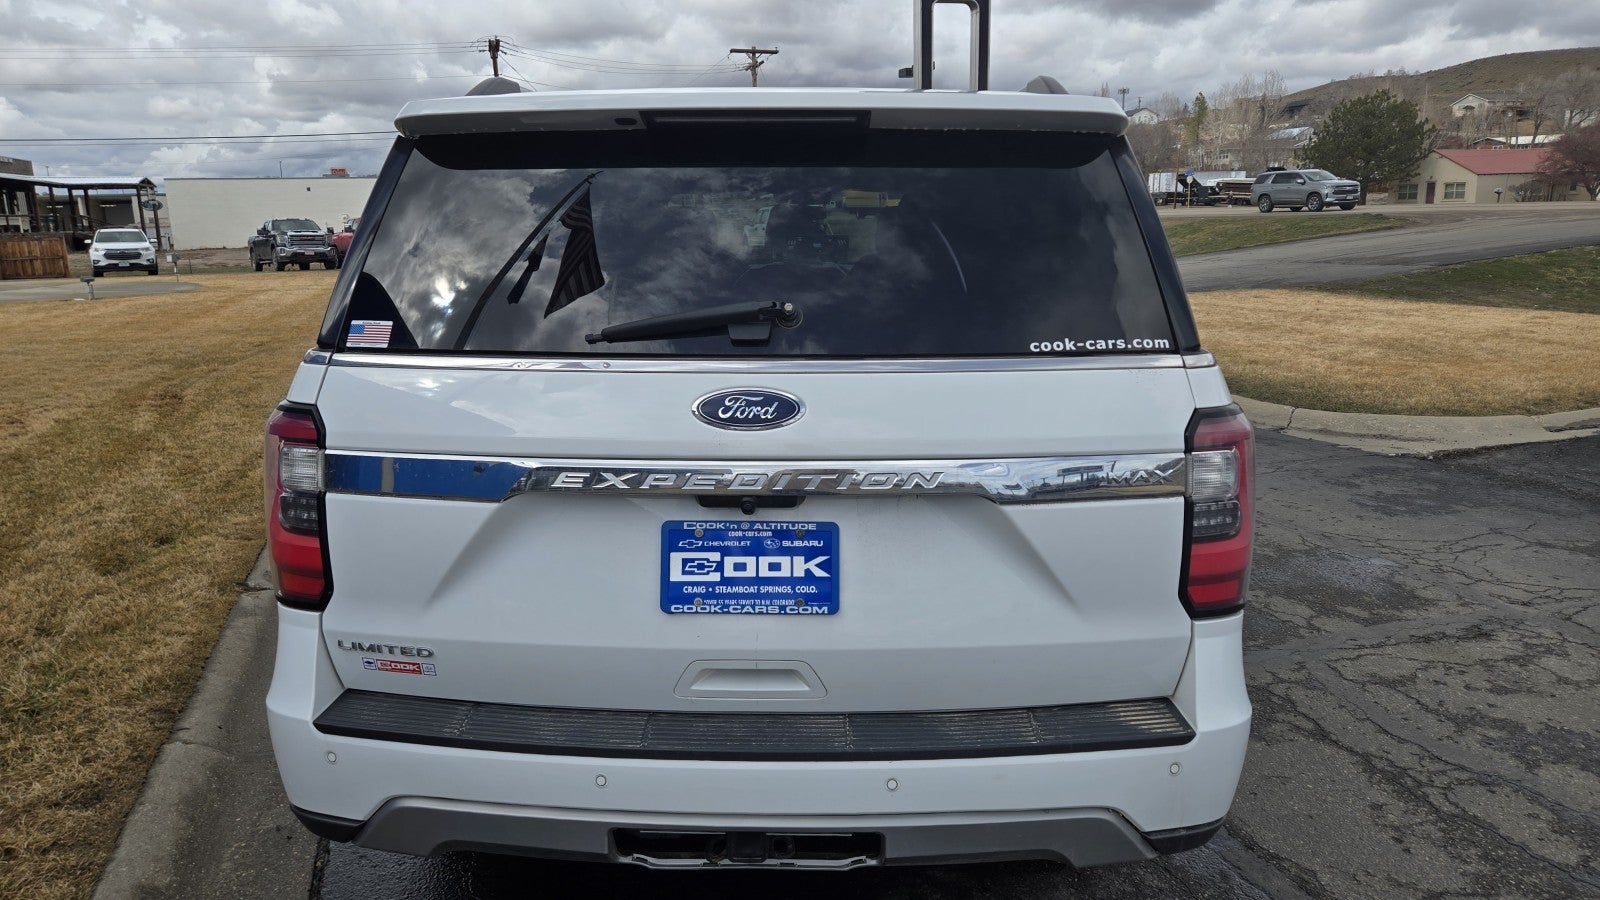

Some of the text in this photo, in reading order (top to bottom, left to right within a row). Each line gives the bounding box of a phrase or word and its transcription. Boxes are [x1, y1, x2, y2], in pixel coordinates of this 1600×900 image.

[1030, 338, 1170, 352] cook-cars.com
[718, 396, 779, 419] Ford
[550, 471, 945, 490] EXPEDITION
[1106, 469, 1173, 486] MAX
[741, 522, 750, 530] @
[753, 522, 817, 530] ALTITUDE
[670, 552, 831, 582] COOK
[760, 586, 793, 594] SPRINGS,
[670, 605, 828, 614] COOK-CARS.COM
[337, 639, 434, 658] LIMITED
[377, 661, 420, 671] COOK
